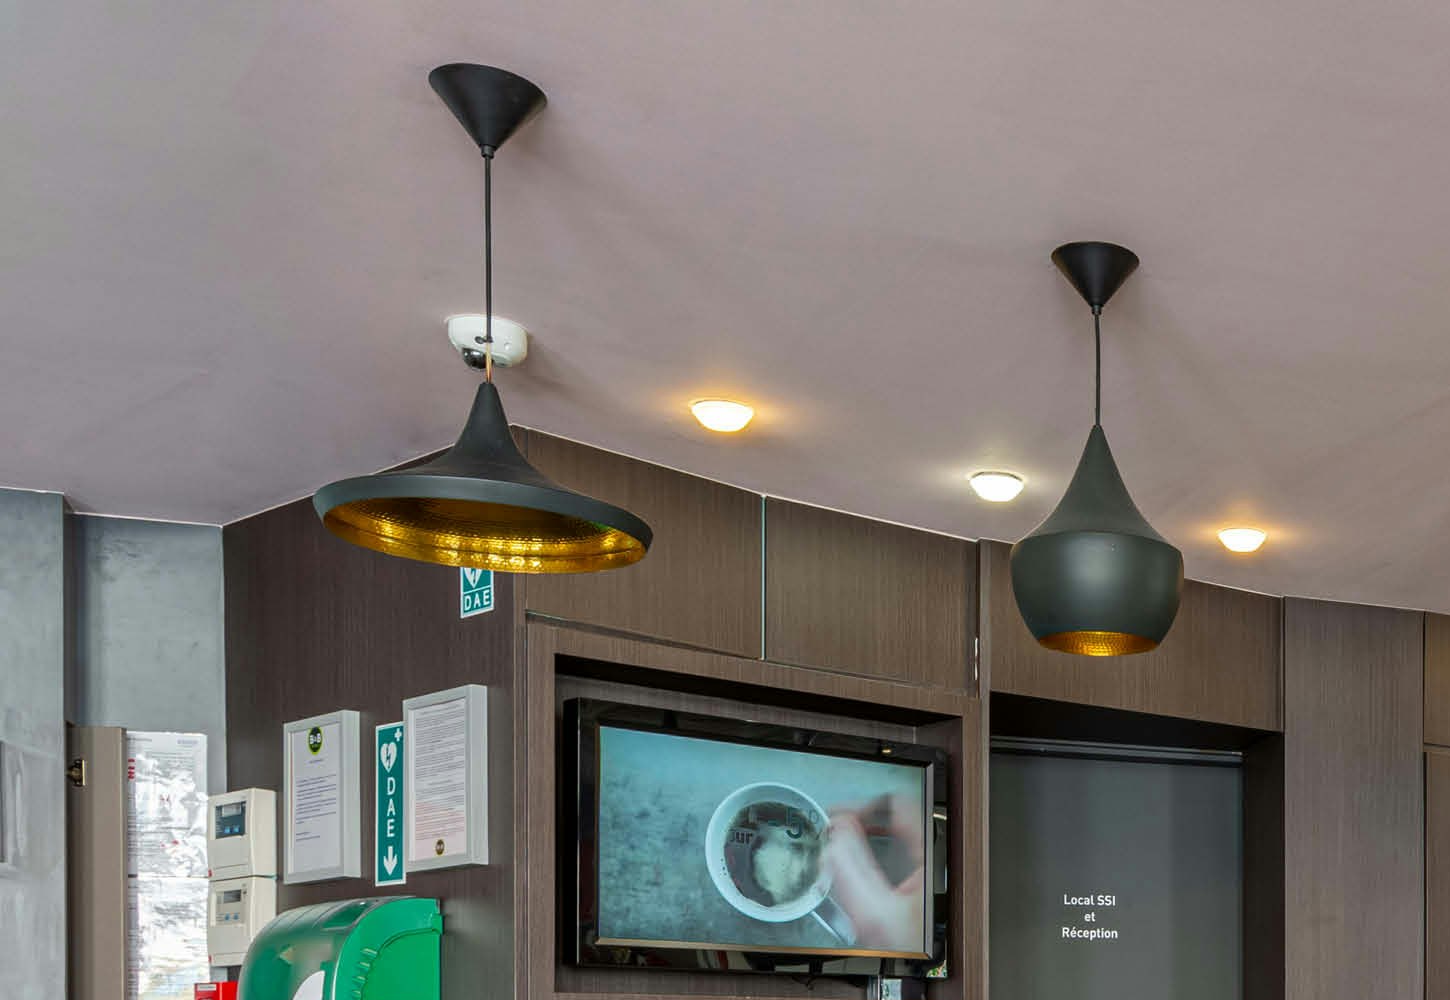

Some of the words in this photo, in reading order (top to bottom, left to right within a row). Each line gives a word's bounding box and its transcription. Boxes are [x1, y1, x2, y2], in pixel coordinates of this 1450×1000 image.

[464, 589, 491, 611] DAE
[386, 776, 396, 838] DAE
[1063, 894, 1095, 906] Local
[1097, 894, 1116, 906] SSI
[1084, 911, 1096, 922] et
[1061, 926, 1118, 941] Réception
